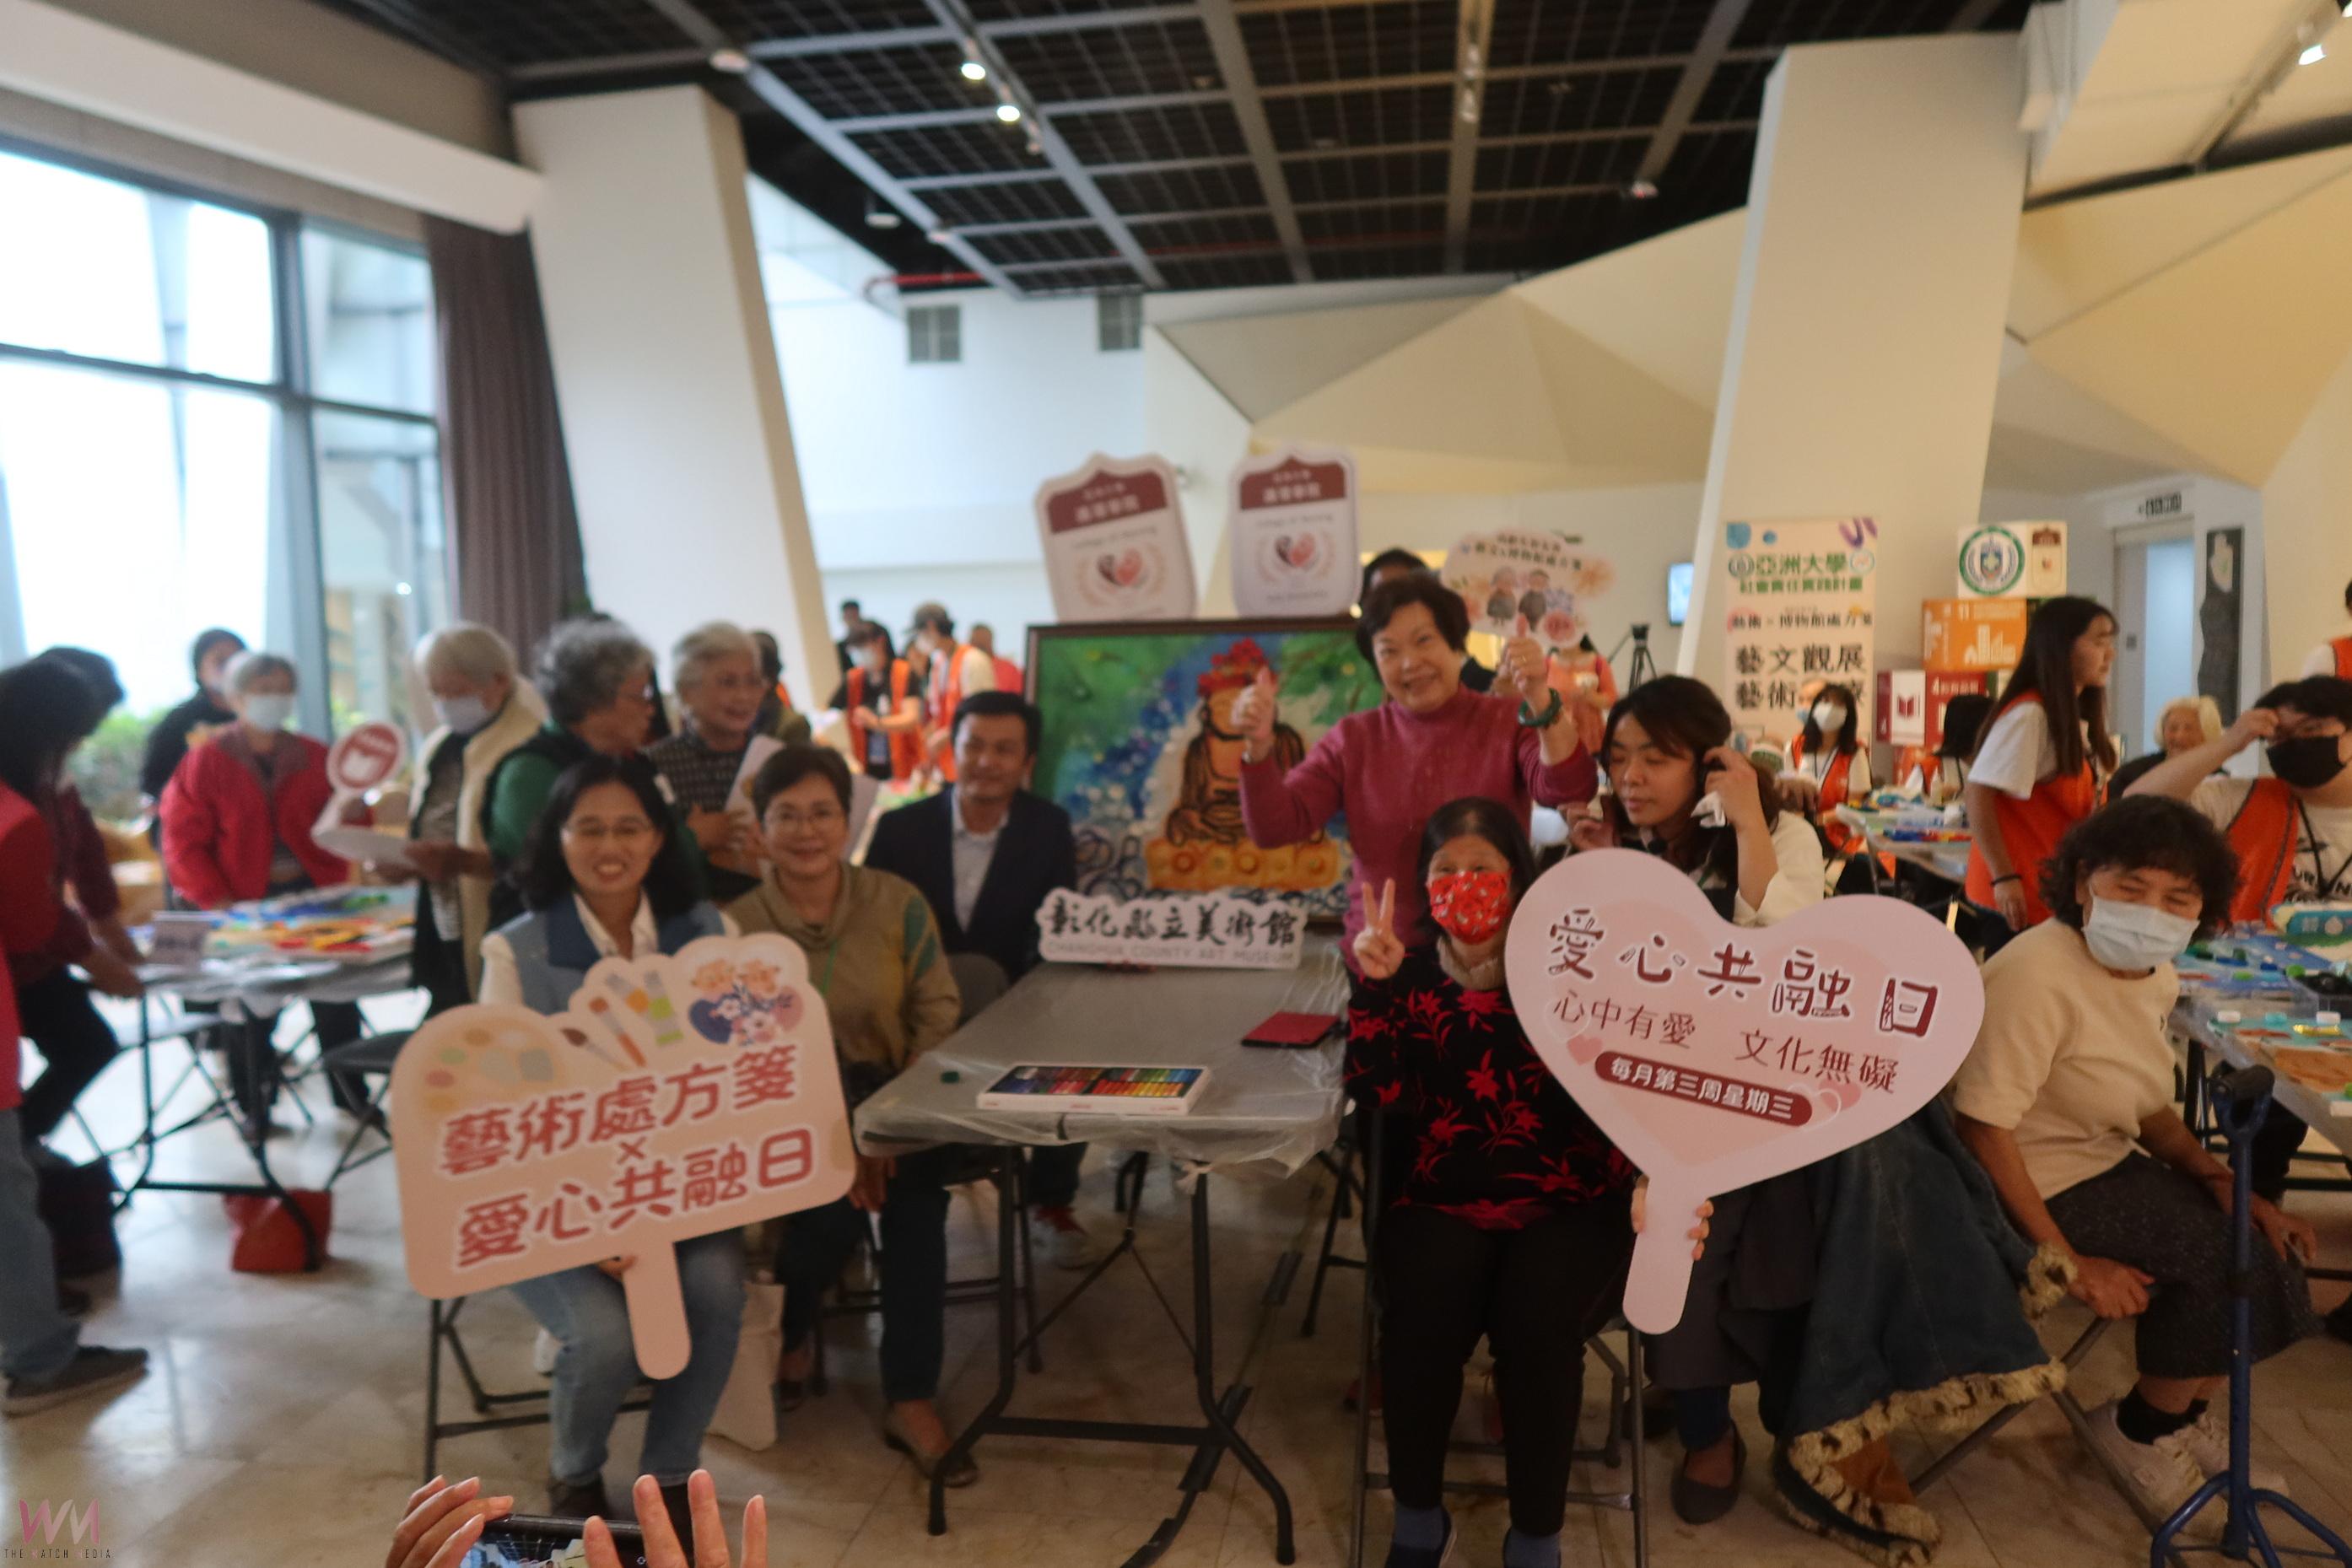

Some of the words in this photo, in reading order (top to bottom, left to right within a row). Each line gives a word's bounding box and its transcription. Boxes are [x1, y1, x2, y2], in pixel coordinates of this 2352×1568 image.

[1756, 553, 1846, 576] 亞洲大學
[1736, 644, 1866, 675] 藝文觀展
[1549, 908, 1939, 1037] 愛心共融日
[1553, 988, 1697, 1051] 心中有愛
[1734, 1028, 1900, 1094] 文化無礙
[1610, 1056, 1794, 1121] 每月第三周星期三
[440, 1044, 797, 1175] 藝術處方箋
[456, 1128, 813, 1268] 愛心共融日
